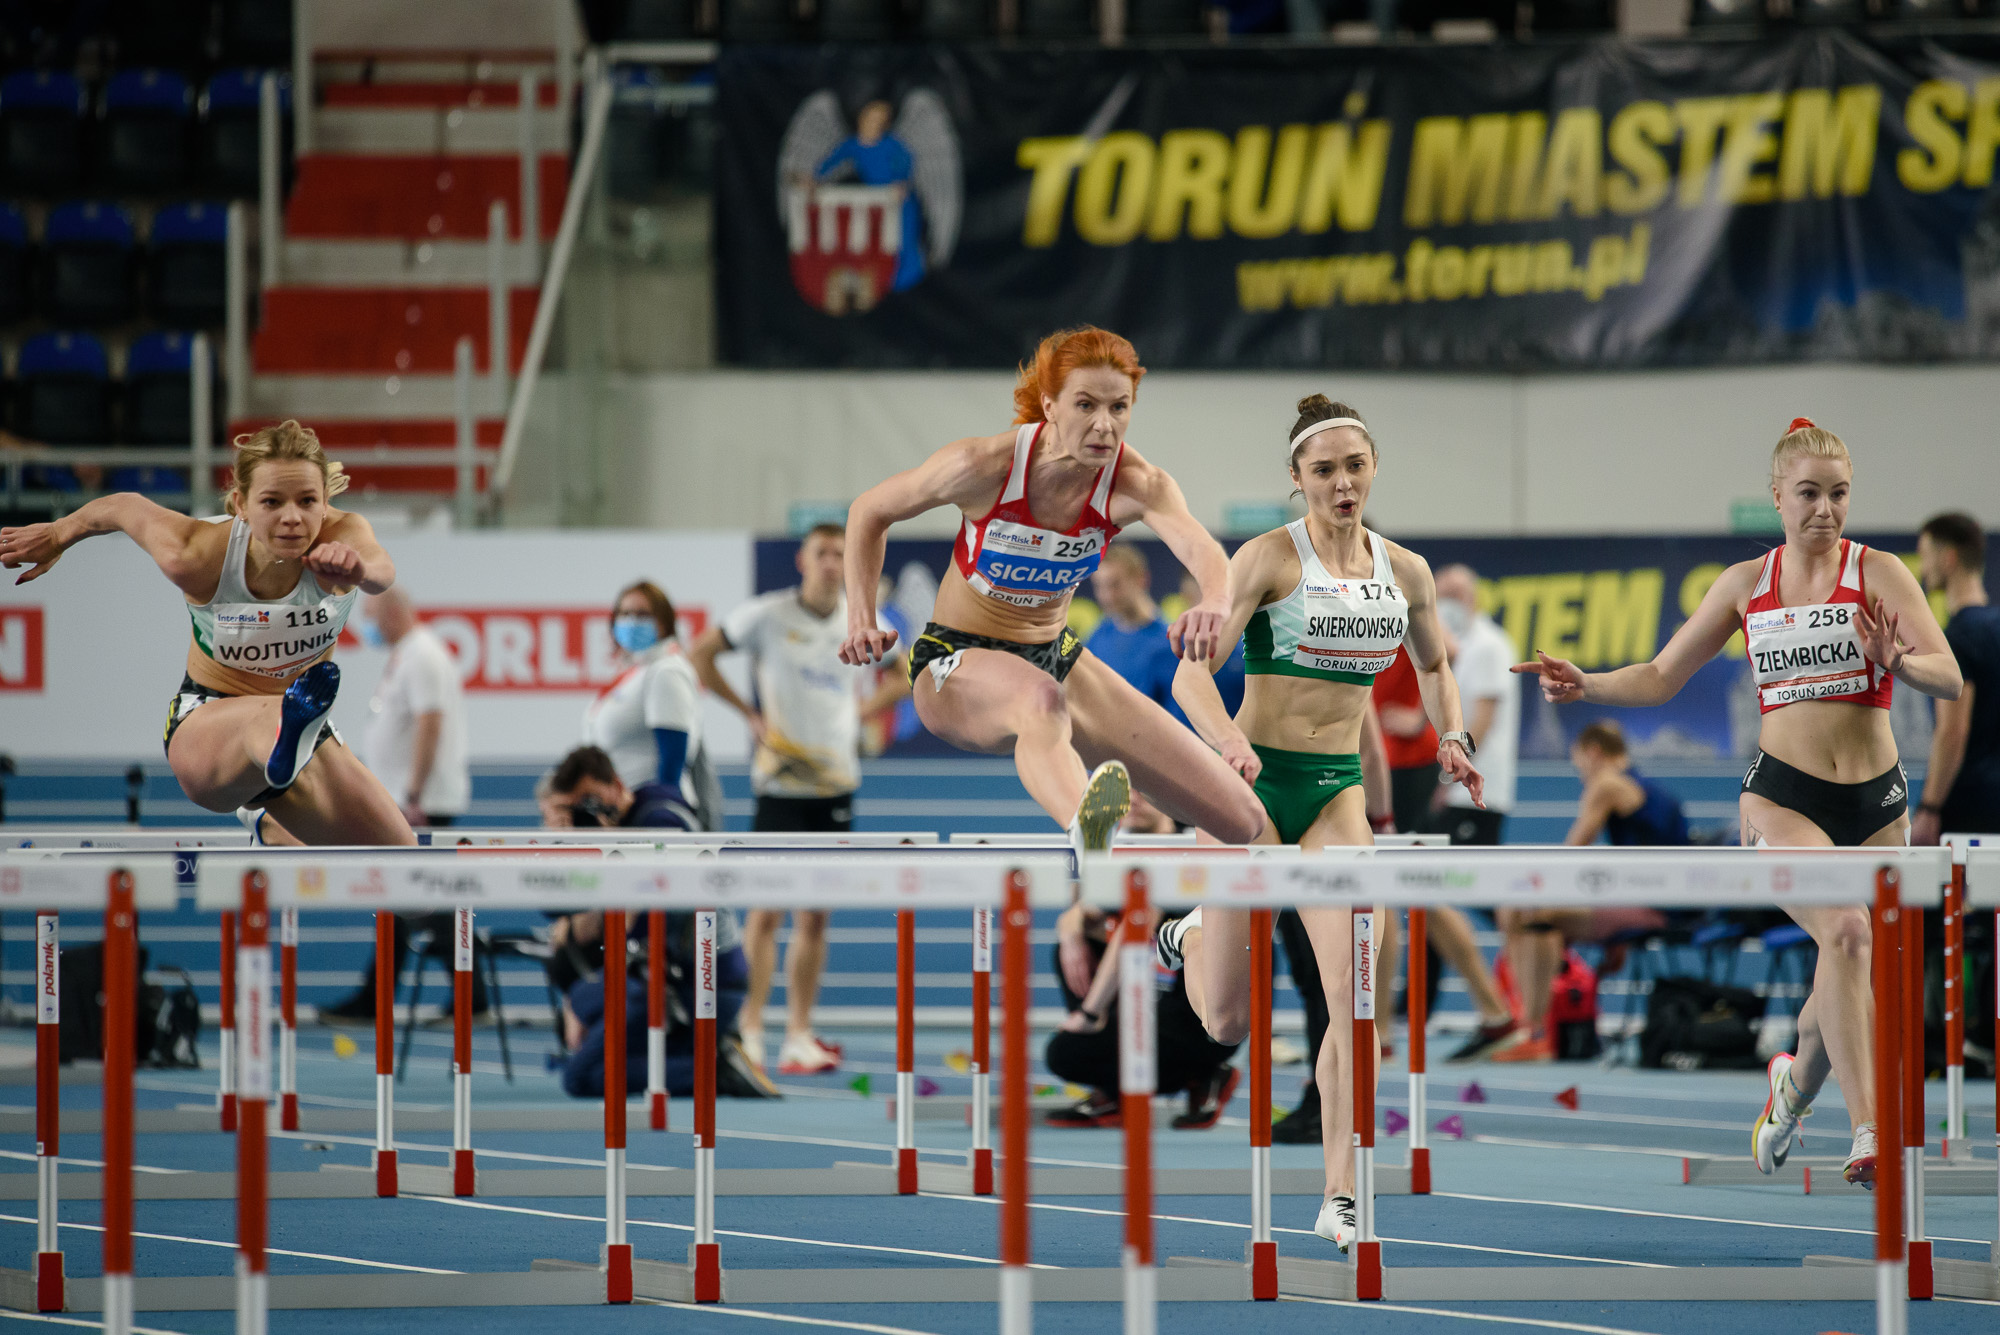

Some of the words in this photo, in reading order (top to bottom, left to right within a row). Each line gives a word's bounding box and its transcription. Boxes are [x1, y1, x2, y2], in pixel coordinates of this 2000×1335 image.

[1017, 91, 1393, 248] TORUŃ
[1405, 82, 1883, 228] MIASTEM
[1236, 224, 1652, 313] www.torun.pl
[988, 529, 1030, 545] InterRisk
[1054, 538, 1097, 557] 250
[987, 562, 1089, 585] SICIARZ
[987, 590, 1034, 606] TORUŃ
[1360, 583, 1396, 600] 174
[218, 614, 257, 622] InterRisk
[286, 608, 329, 628] 118
[1307, 616, 1404, 639] SKIERKOWSKA
[1750, 619, 1785, 631] InterRisk
[1808, 608, 1849, 628] 258
[219, 627, 335, 661] WOJTUNIK
[1315, 658, 1357, 671] TORUŃ
[1360, 661, 1385, 672] 2022
[1755, 641, 1860, 673] ZIEMBICKA
[1777, 684, 1816, 701] TORUŃ
[1819, 682, 1850, 696] 2022
[42, 941, 56, 997] polanik
[700, 938, 714, 992] polanik
[1358, 939, 1372, 993] polanik
